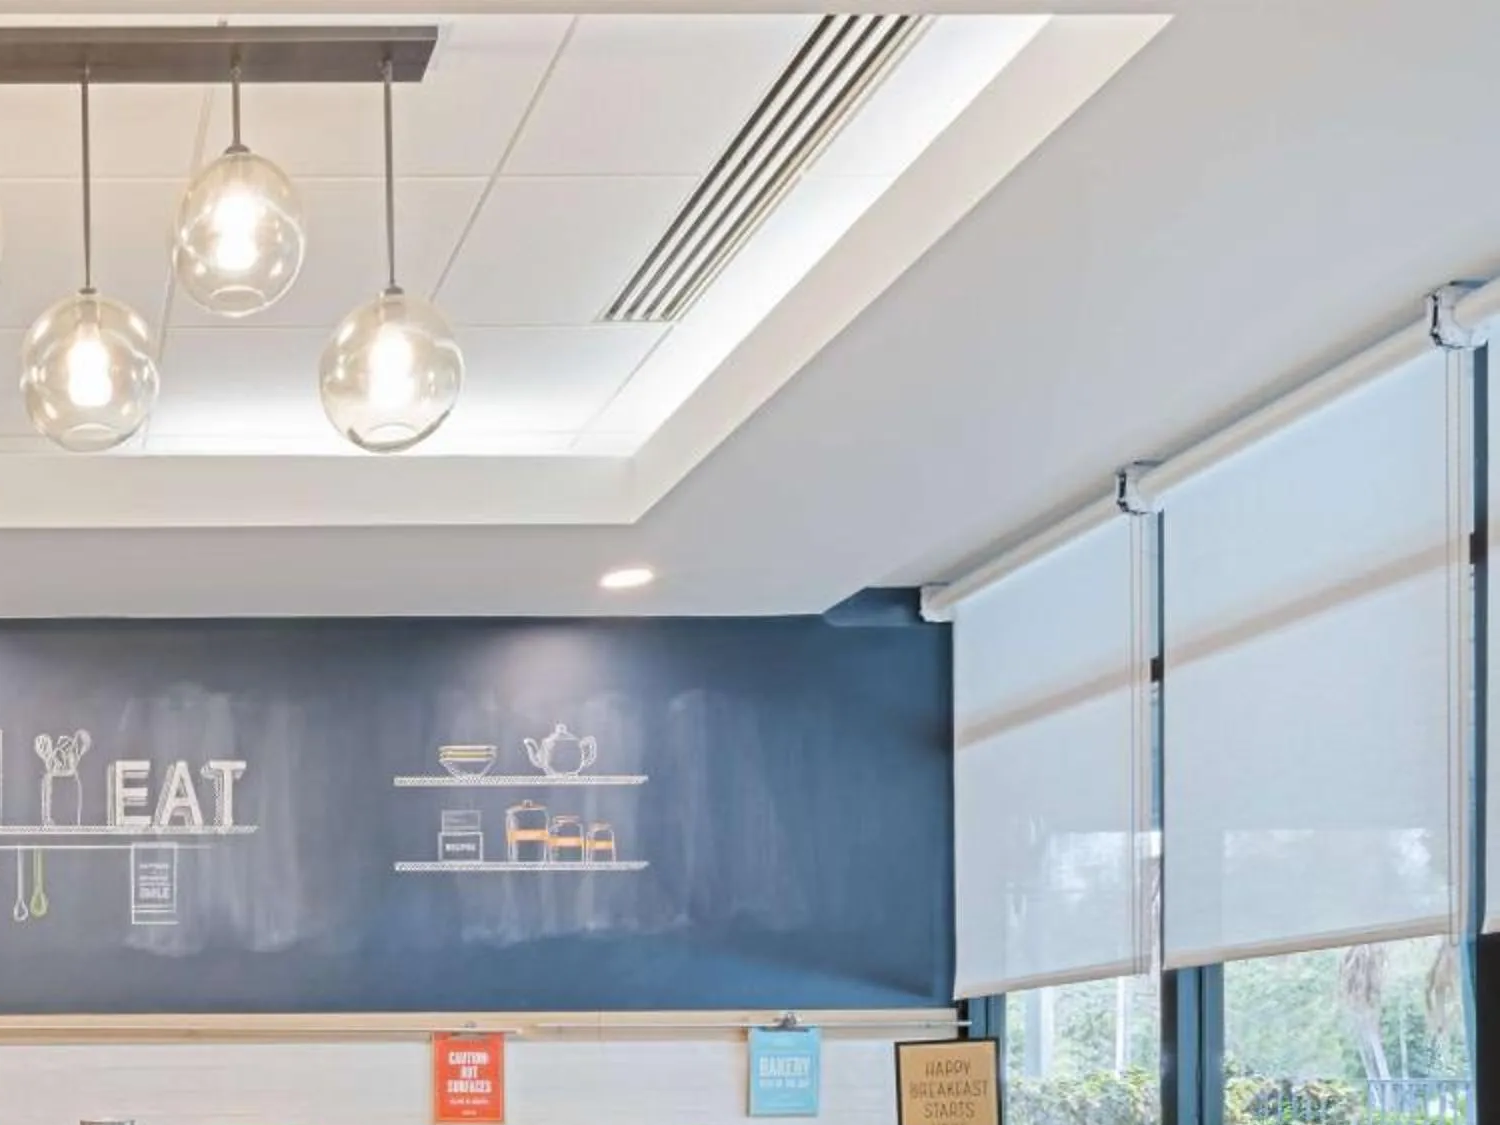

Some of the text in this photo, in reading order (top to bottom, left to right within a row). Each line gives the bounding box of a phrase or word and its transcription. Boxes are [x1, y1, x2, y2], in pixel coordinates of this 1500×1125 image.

[106, 760, 248, 827] EAT
[759, 1056, 811, 1077] BAKERY
[925, 1059, 971, 1078] HAPPY
[909, 1080, 988, 1099] BREAKFAST
[923, 1100, 976, 1119] STARTS
